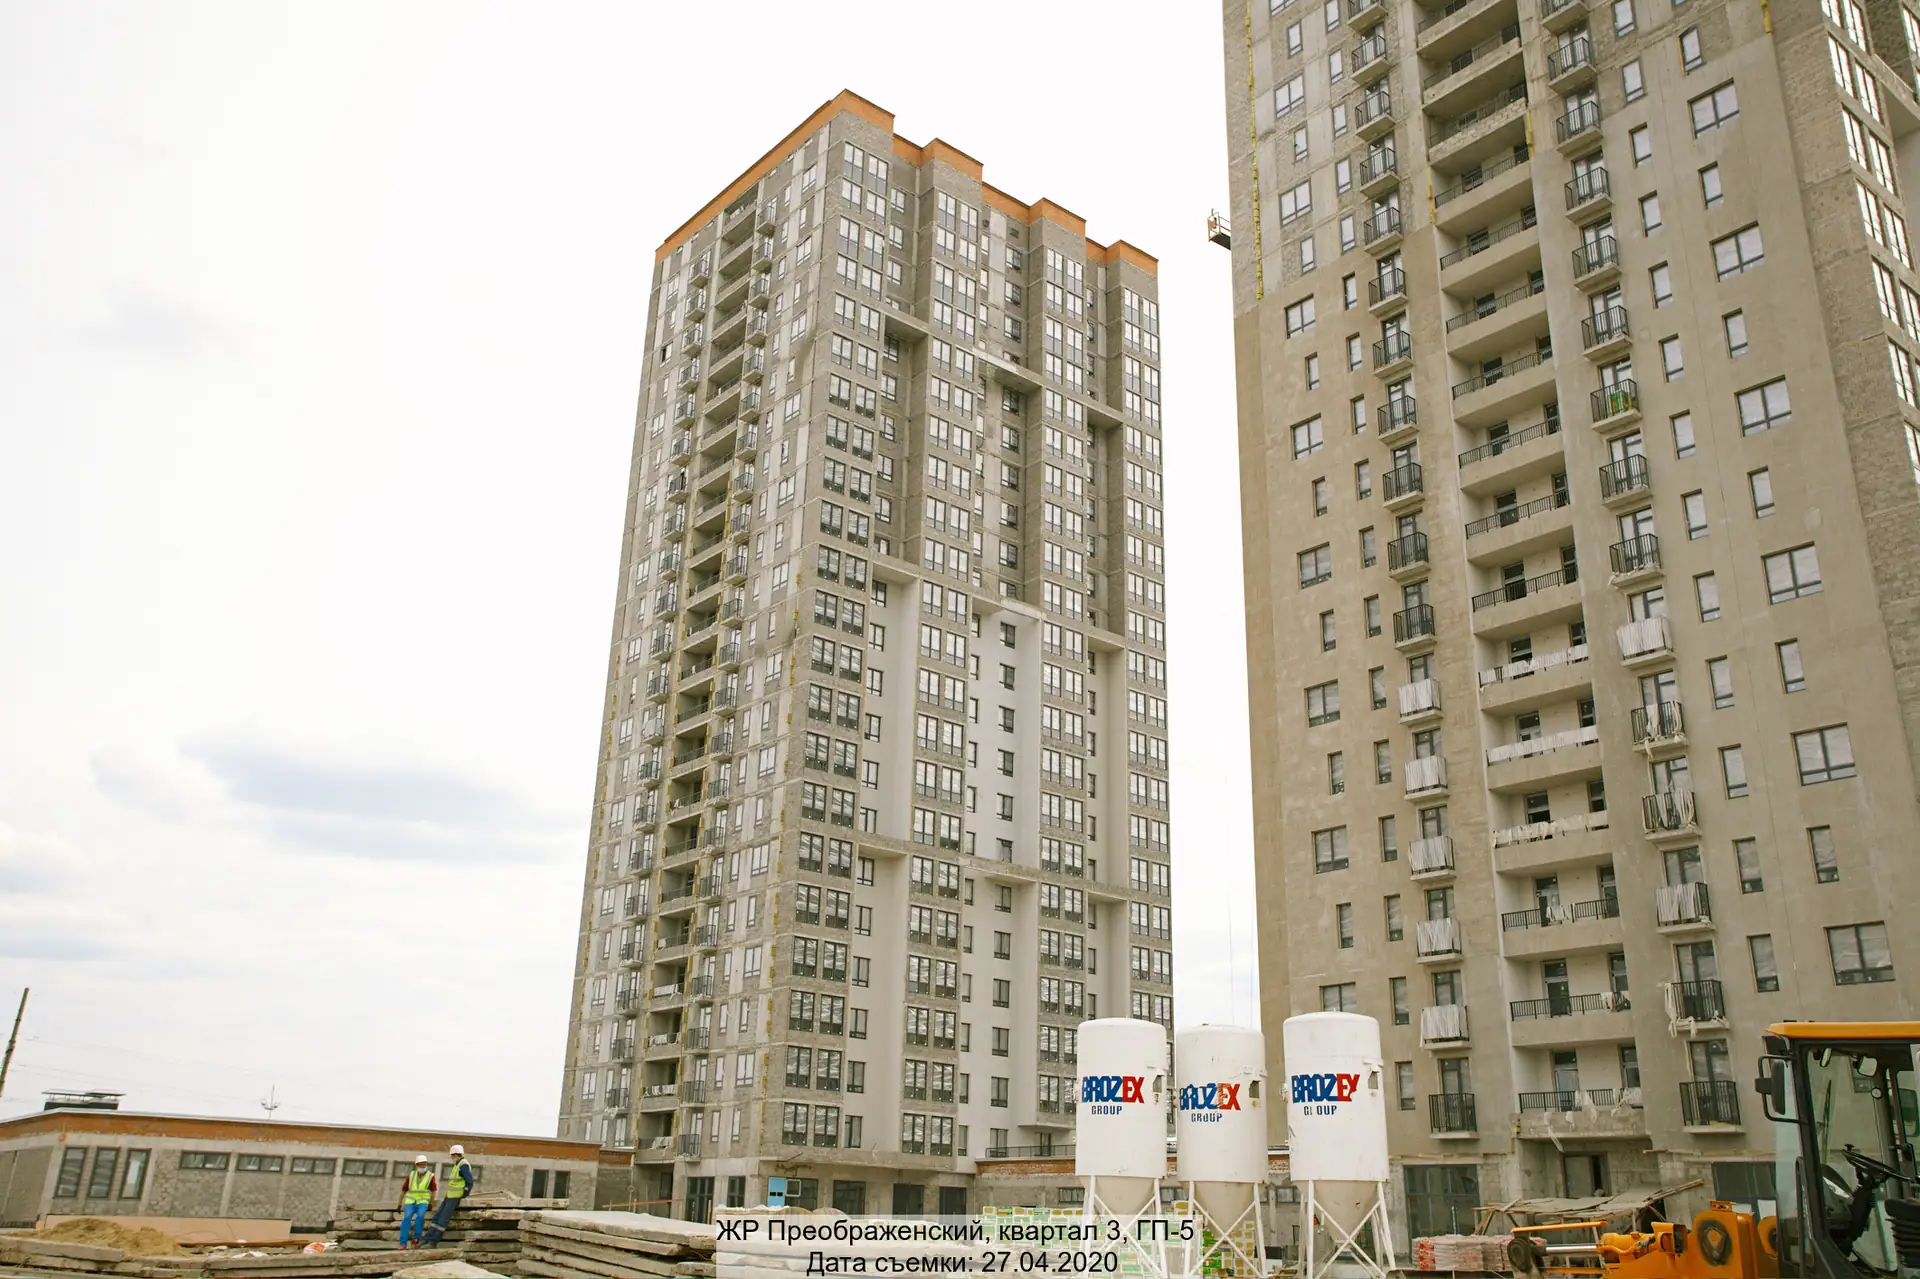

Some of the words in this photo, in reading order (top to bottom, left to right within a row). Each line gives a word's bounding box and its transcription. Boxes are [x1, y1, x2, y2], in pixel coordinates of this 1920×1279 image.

[1081, 1075, 1145, 1103] BROZEX
[1091, 1105, 1123, 1115] GROUP
[1191, 1112, 1223, 1123] GROUP
